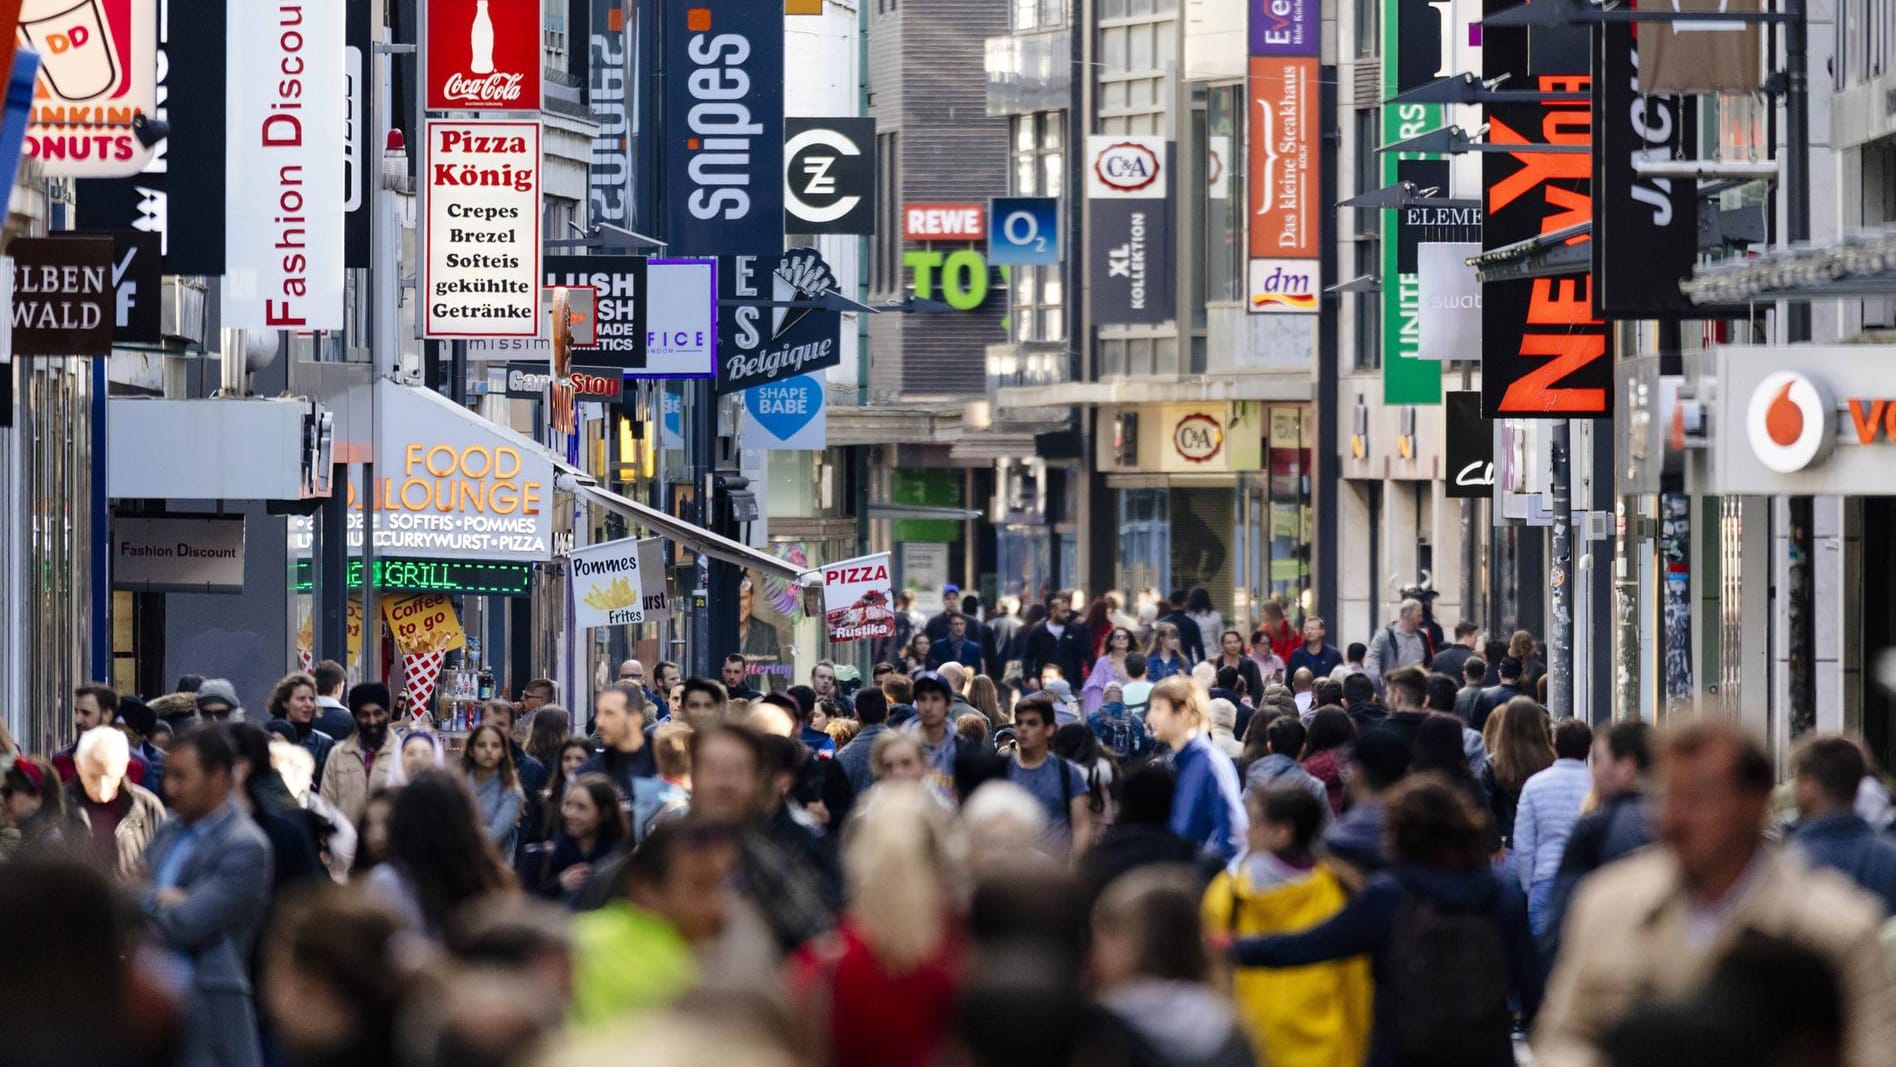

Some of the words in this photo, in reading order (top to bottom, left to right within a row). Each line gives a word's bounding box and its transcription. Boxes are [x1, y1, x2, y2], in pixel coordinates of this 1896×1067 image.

[46, 26, 89, 54] DD
[444, 69, 523, 100] Coca-Cola
[1278, 65, 1296, 153] Steakhaus
[688, 34, 763, 219] snipes
[1630, 48, 1673, 226] JAC
[440, 130, 526, 153] Pizza
[434, 164, 532, 191] König
[1106, 155, 1149, 178] C&A
[1278, 159, 1296, 209] kleine
[447, 203, 519, 221] Crepes
[907, 209, 980, 234] REWE
[450, 228, 516, 243] Brezel
[1278, 213, 1296, 248] Das
[266, 165, 306, 326] Fashion
[446, 253, 519, 268] Softeis
[1108, 243, 1130, 278] XL
[1131, 212, 1146, 310] KOLLEKTION
[12, 265, 105, 293] LBEN
[436, 279, 529, 295] gekühlte
[1264, 267, 1309, 292] dm
[12, 302, 102, 330] WALD
[433, 303, 532, 318] Getränke
[726, 338, 832, 381] Belgique
[509, 370, 620, 396] GamStop
[759, 387, 808, 399] SHAPE
[759, 399, 808, 414] BABE
[1180, 427, 1213, 450] C&A
[405, 443, 522, 479] FOOD
[383, 477, 541, 515] LOUNGE
[464, 516, 537, 534] POMMES
[120, 542, 173, 556] Fashion
[176, 543, 237, 559] Discount
[381, 530, 491, 549] CURRYWURST
[498, 534, 545, 552] PIZZA
[386, 564, 457, 587] GRILL
[573, 556, 637, 577] Pommes
[825, 564, 889, 586] PIZZA
[391, 592, 445, 621] Coffee
[608, 608, 642, 624] Frites
[398, 622, 417, 637] to
[423, 610, 446, 632] go
[836, 623, 888, 639] Rustika
